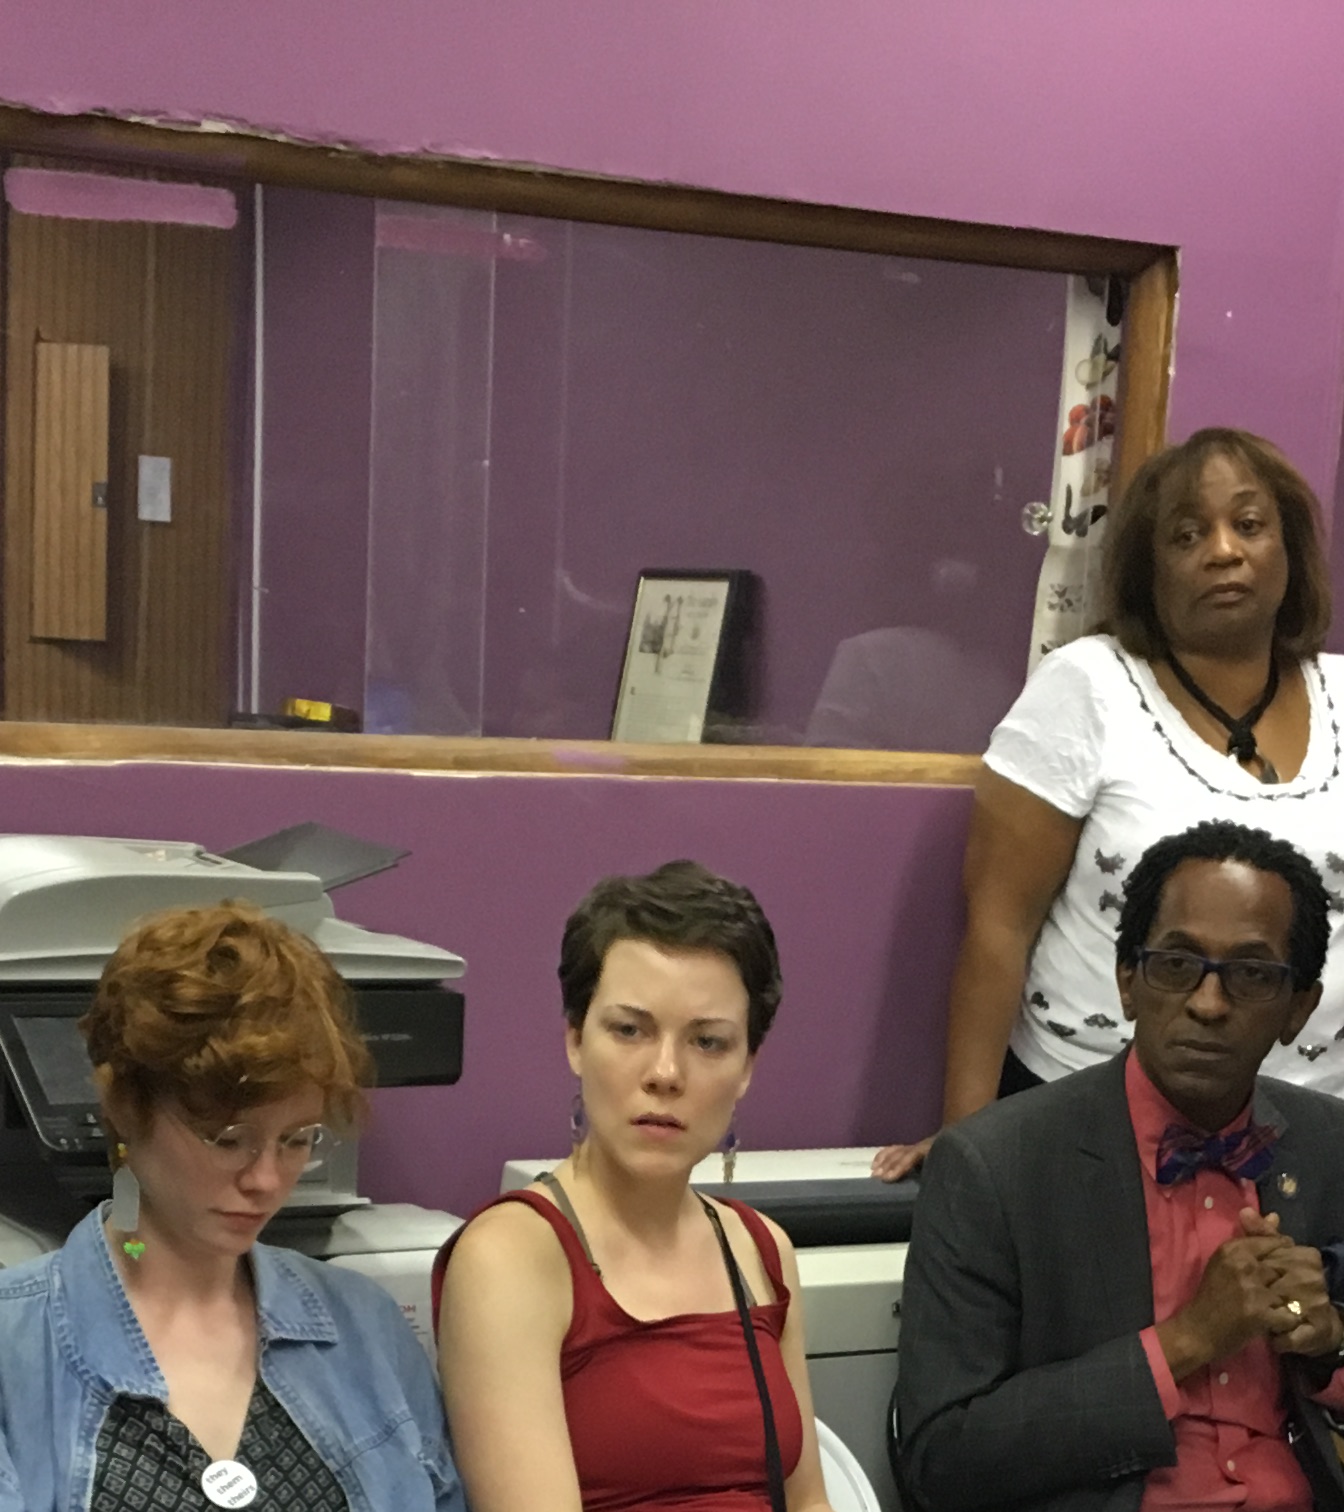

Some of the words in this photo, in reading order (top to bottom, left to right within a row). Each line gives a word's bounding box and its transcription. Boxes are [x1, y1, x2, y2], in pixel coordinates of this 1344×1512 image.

[205, 1467, 229, 1484] they
[216, 1474, 244, 1495] them
[227, 1484, 256, 1506] theirs
